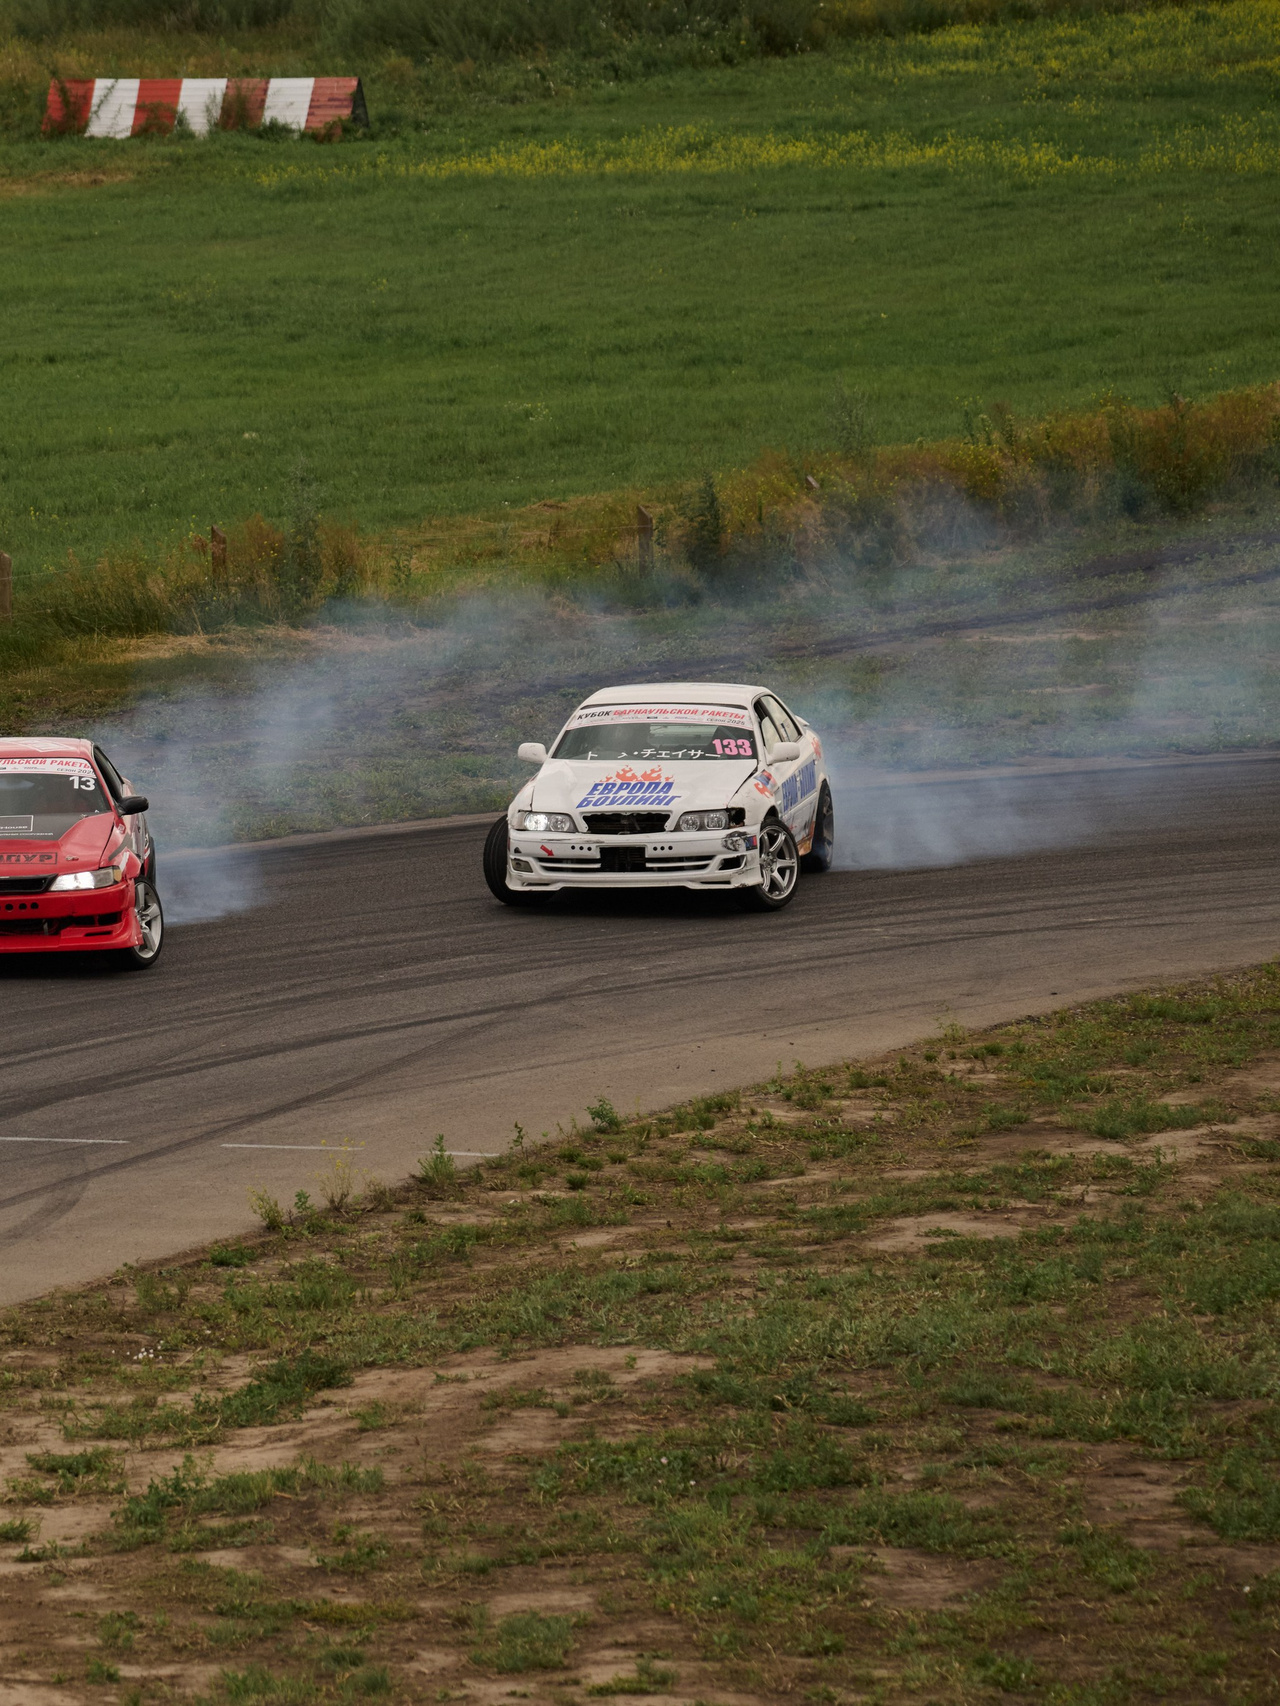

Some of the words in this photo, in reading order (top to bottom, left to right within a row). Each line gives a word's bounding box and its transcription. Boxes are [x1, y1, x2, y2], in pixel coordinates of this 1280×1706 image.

[576, 710, 612, 721] КУБОК
[613, 707, 698, 717] БАРНАУЛЬСКОЙ
[701, 709, 745, 720] РАКЕТЫ
[712, 738, 753, 756] 133
[69, 775, 96, 791] 13
[586, 781, 675, 796] ЕВРОПА
[576, 795, 682, 809] БОУЛИНГ
